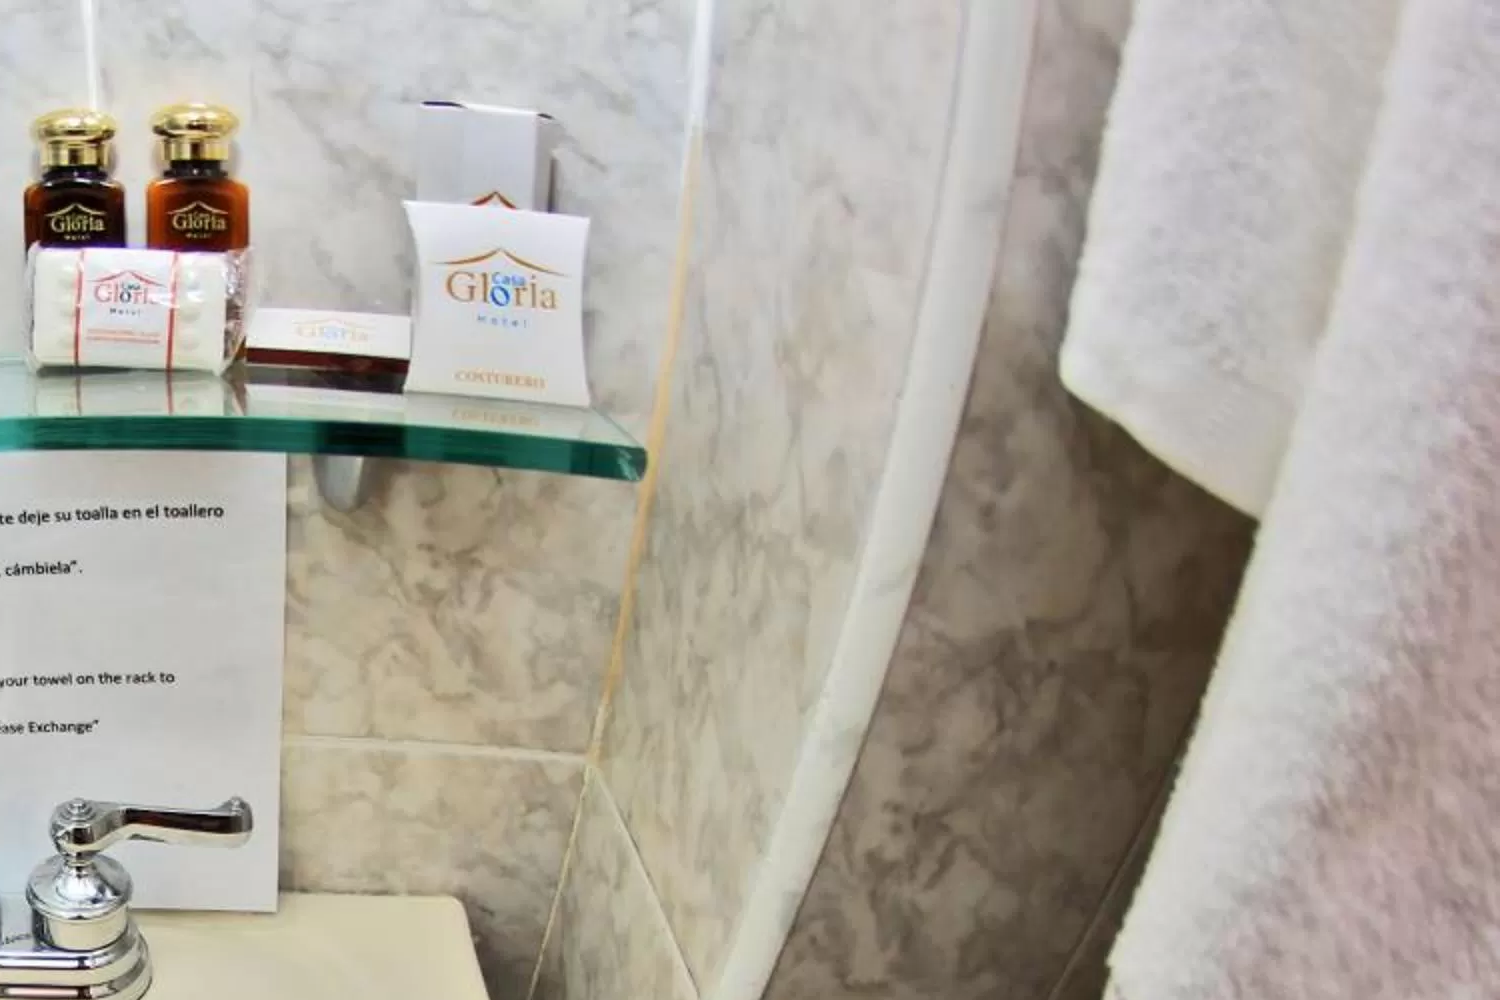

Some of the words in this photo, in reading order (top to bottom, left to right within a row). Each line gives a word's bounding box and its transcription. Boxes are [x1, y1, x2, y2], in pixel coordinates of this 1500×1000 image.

[51, 213, 106, 232] Gloria
[171, 211, 228, 231] Gloria
[492, 271, 527, 287] Casa
[445, 269, 558, 310] Gloria
[17, 509, 50, 526] deje
[54, 512, 72, 523] su
[75, 506, 119, 521] toalla
[122, 508, 142, 519] en
[145, 504, 160, 519] el
[163, 503, 225, 519] toallero
[32, 673, 73, 686] towel
[75, 674, 95, 685] on
[97, 671, 123, 684] the
[125, 671, 157, 684] rack
[159, 672, 176, 683] to
